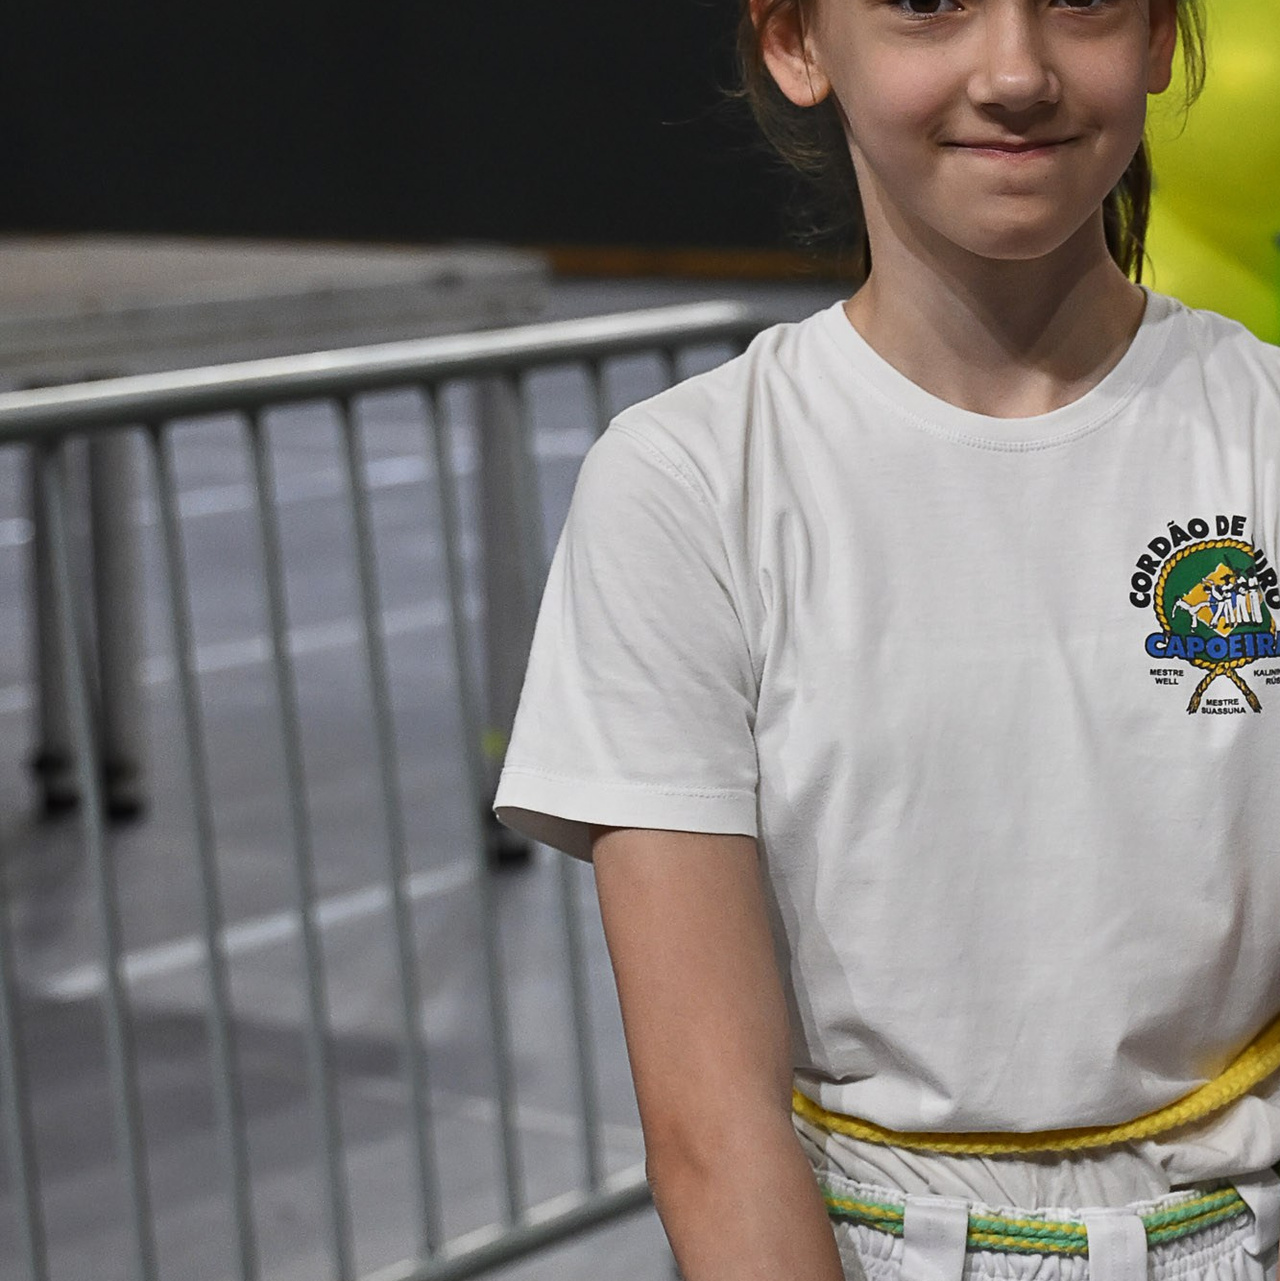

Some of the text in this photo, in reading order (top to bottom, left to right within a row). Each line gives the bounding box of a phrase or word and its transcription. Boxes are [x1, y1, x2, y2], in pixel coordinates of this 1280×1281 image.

[1129, 518, 1210, 608] CORDÃO
[1215, 515, 1247, 536] DE
[1149, 668, 1185, 677] MESTRE
[1154, 677, 1179, 685] WELL
[1205, 698, 1240, 706] MESTRE
[1201, 706, 1247, 715] SUASSUNA
